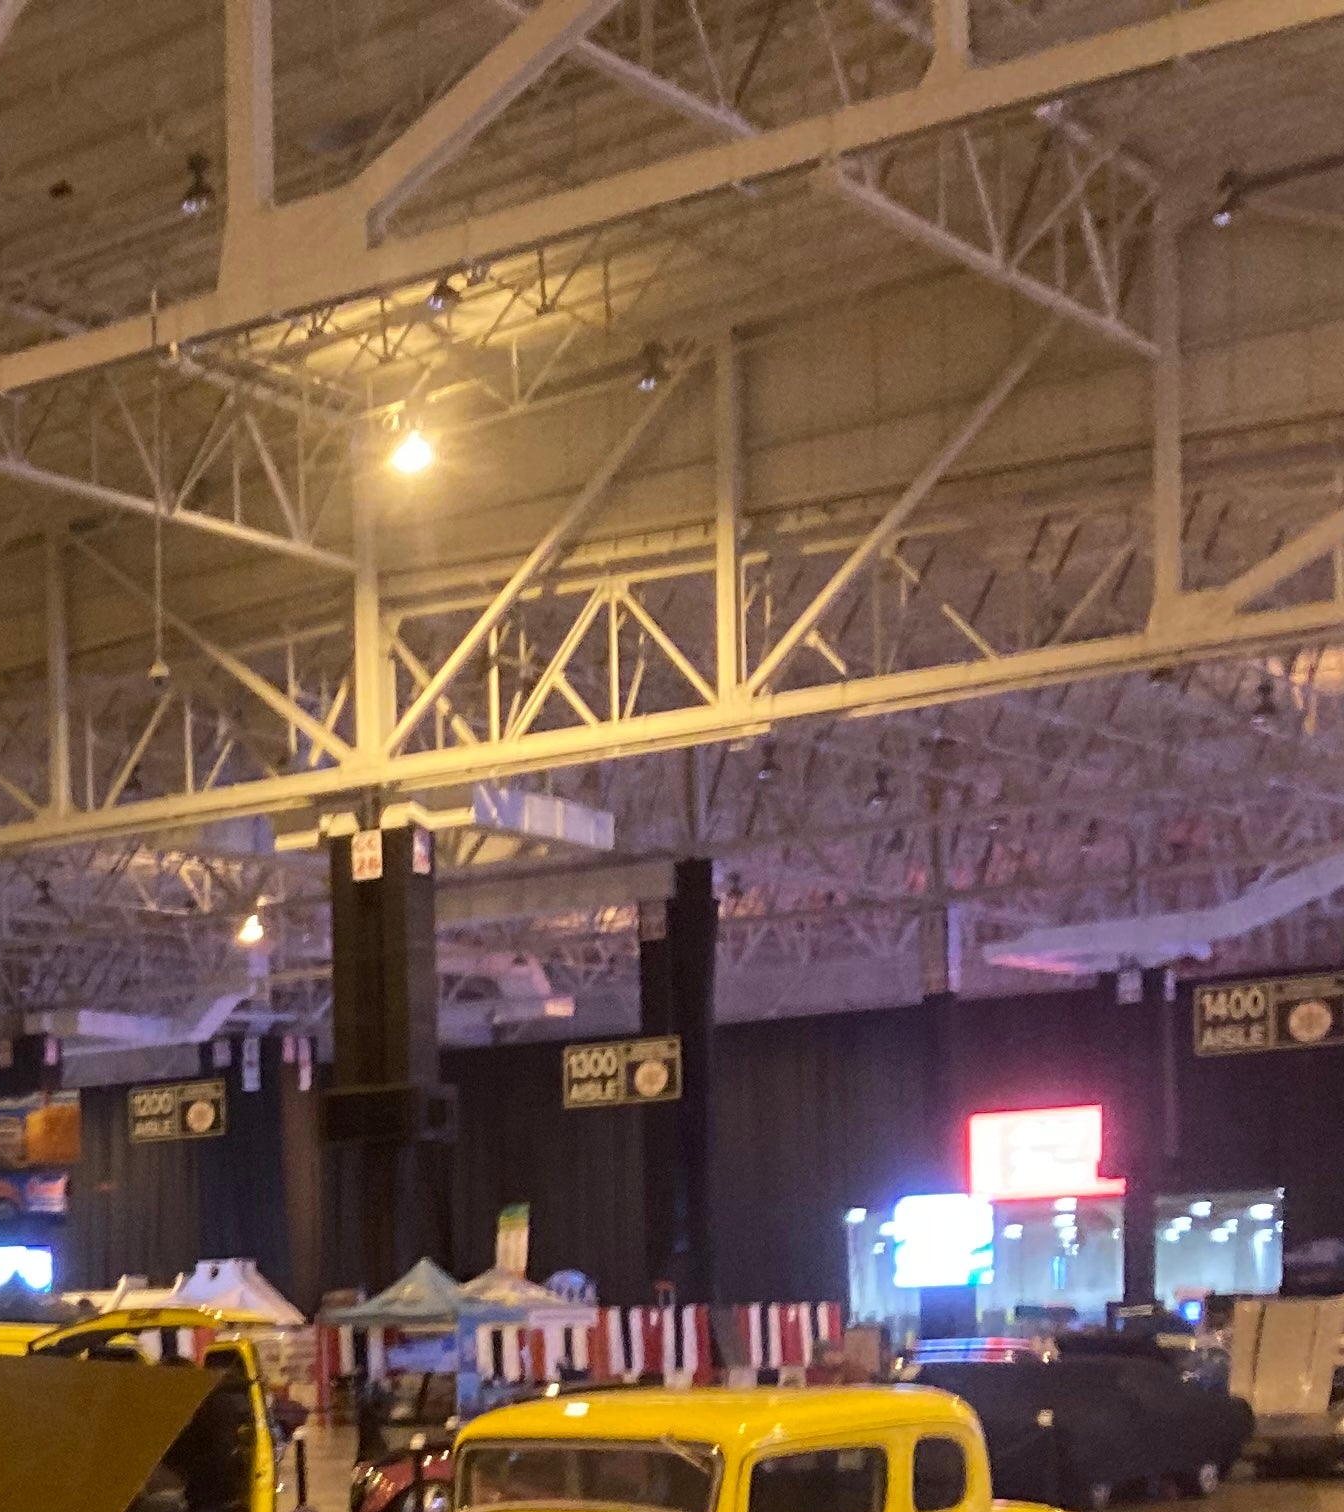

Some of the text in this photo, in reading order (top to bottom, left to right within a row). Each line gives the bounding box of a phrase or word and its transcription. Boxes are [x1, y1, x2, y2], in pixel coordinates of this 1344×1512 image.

[1201, 986, 1265, 1021] 1400
[1202, 1024, 1265, 1047] AISLE
[568, 1049, 617, 1078] 1300
[569, 1080, 619, 1102] AISLE
